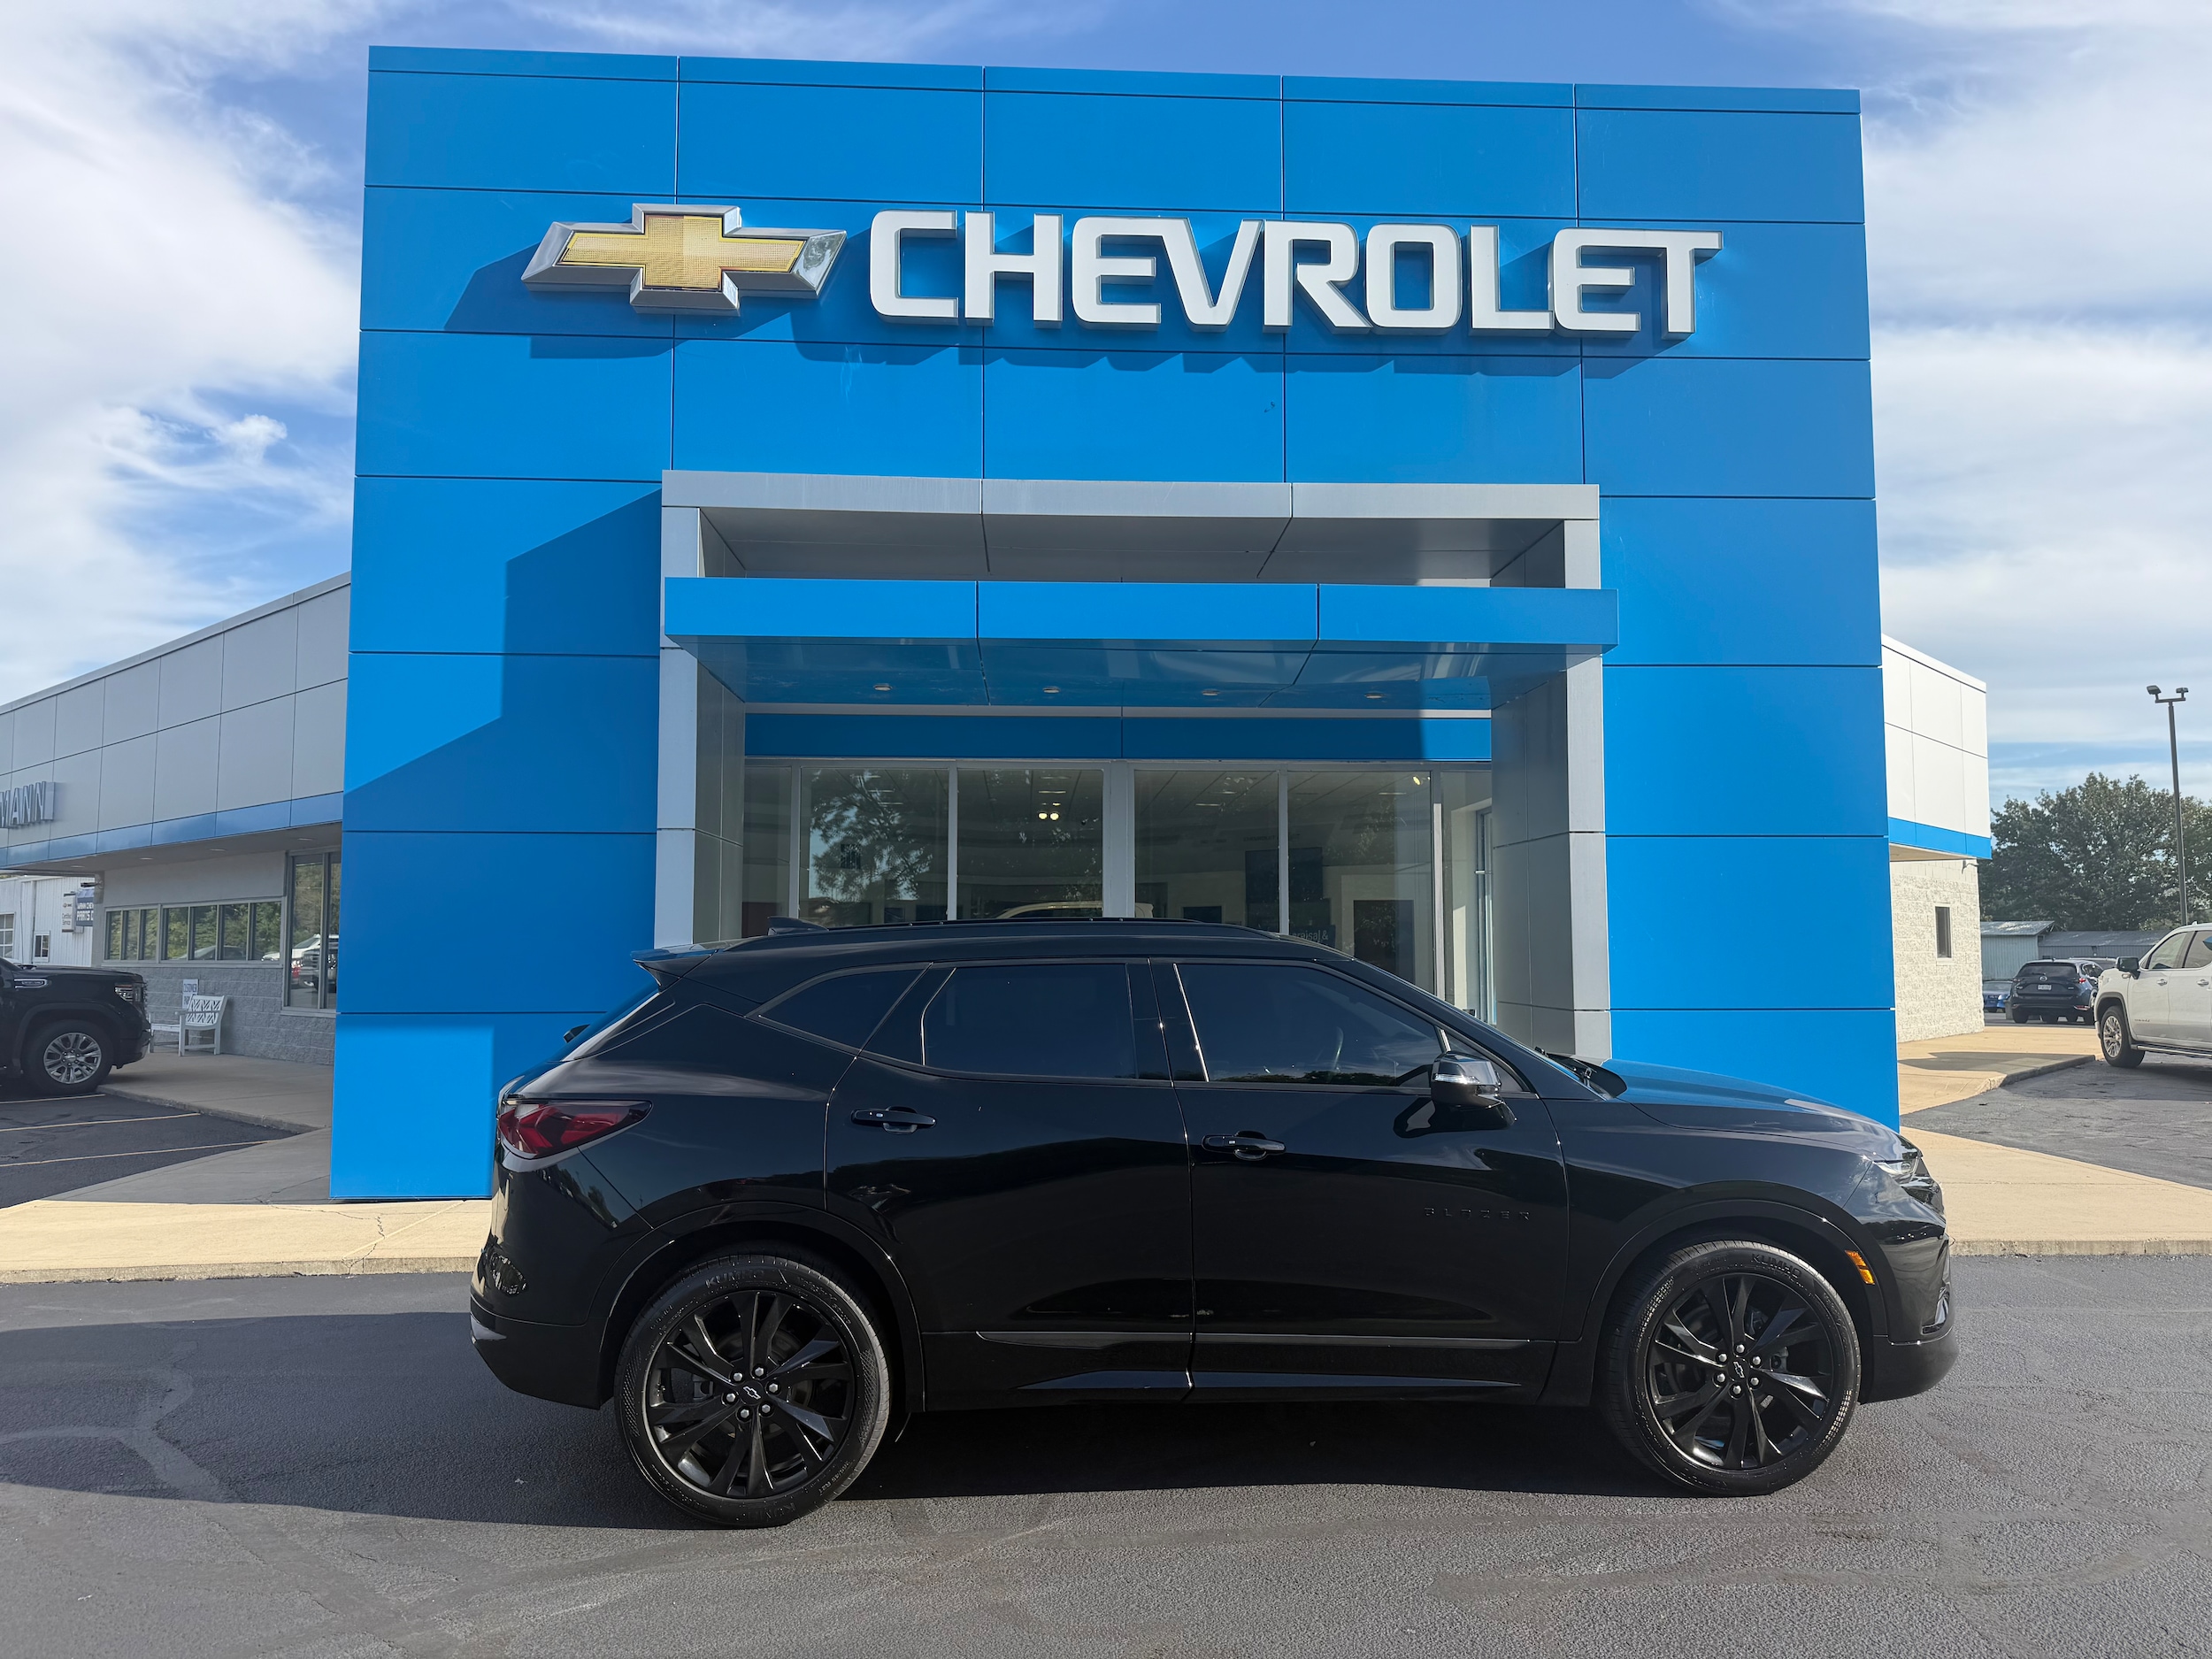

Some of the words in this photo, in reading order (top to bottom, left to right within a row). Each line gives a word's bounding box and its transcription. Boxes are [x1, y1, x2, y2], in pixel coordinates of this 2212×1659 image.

[870, 210, 1723, 337] CHEVROLET
[1424, 1207, 1530, 1221] BLAZER
[1752, 1253, 1802, 1279] KUMHO
